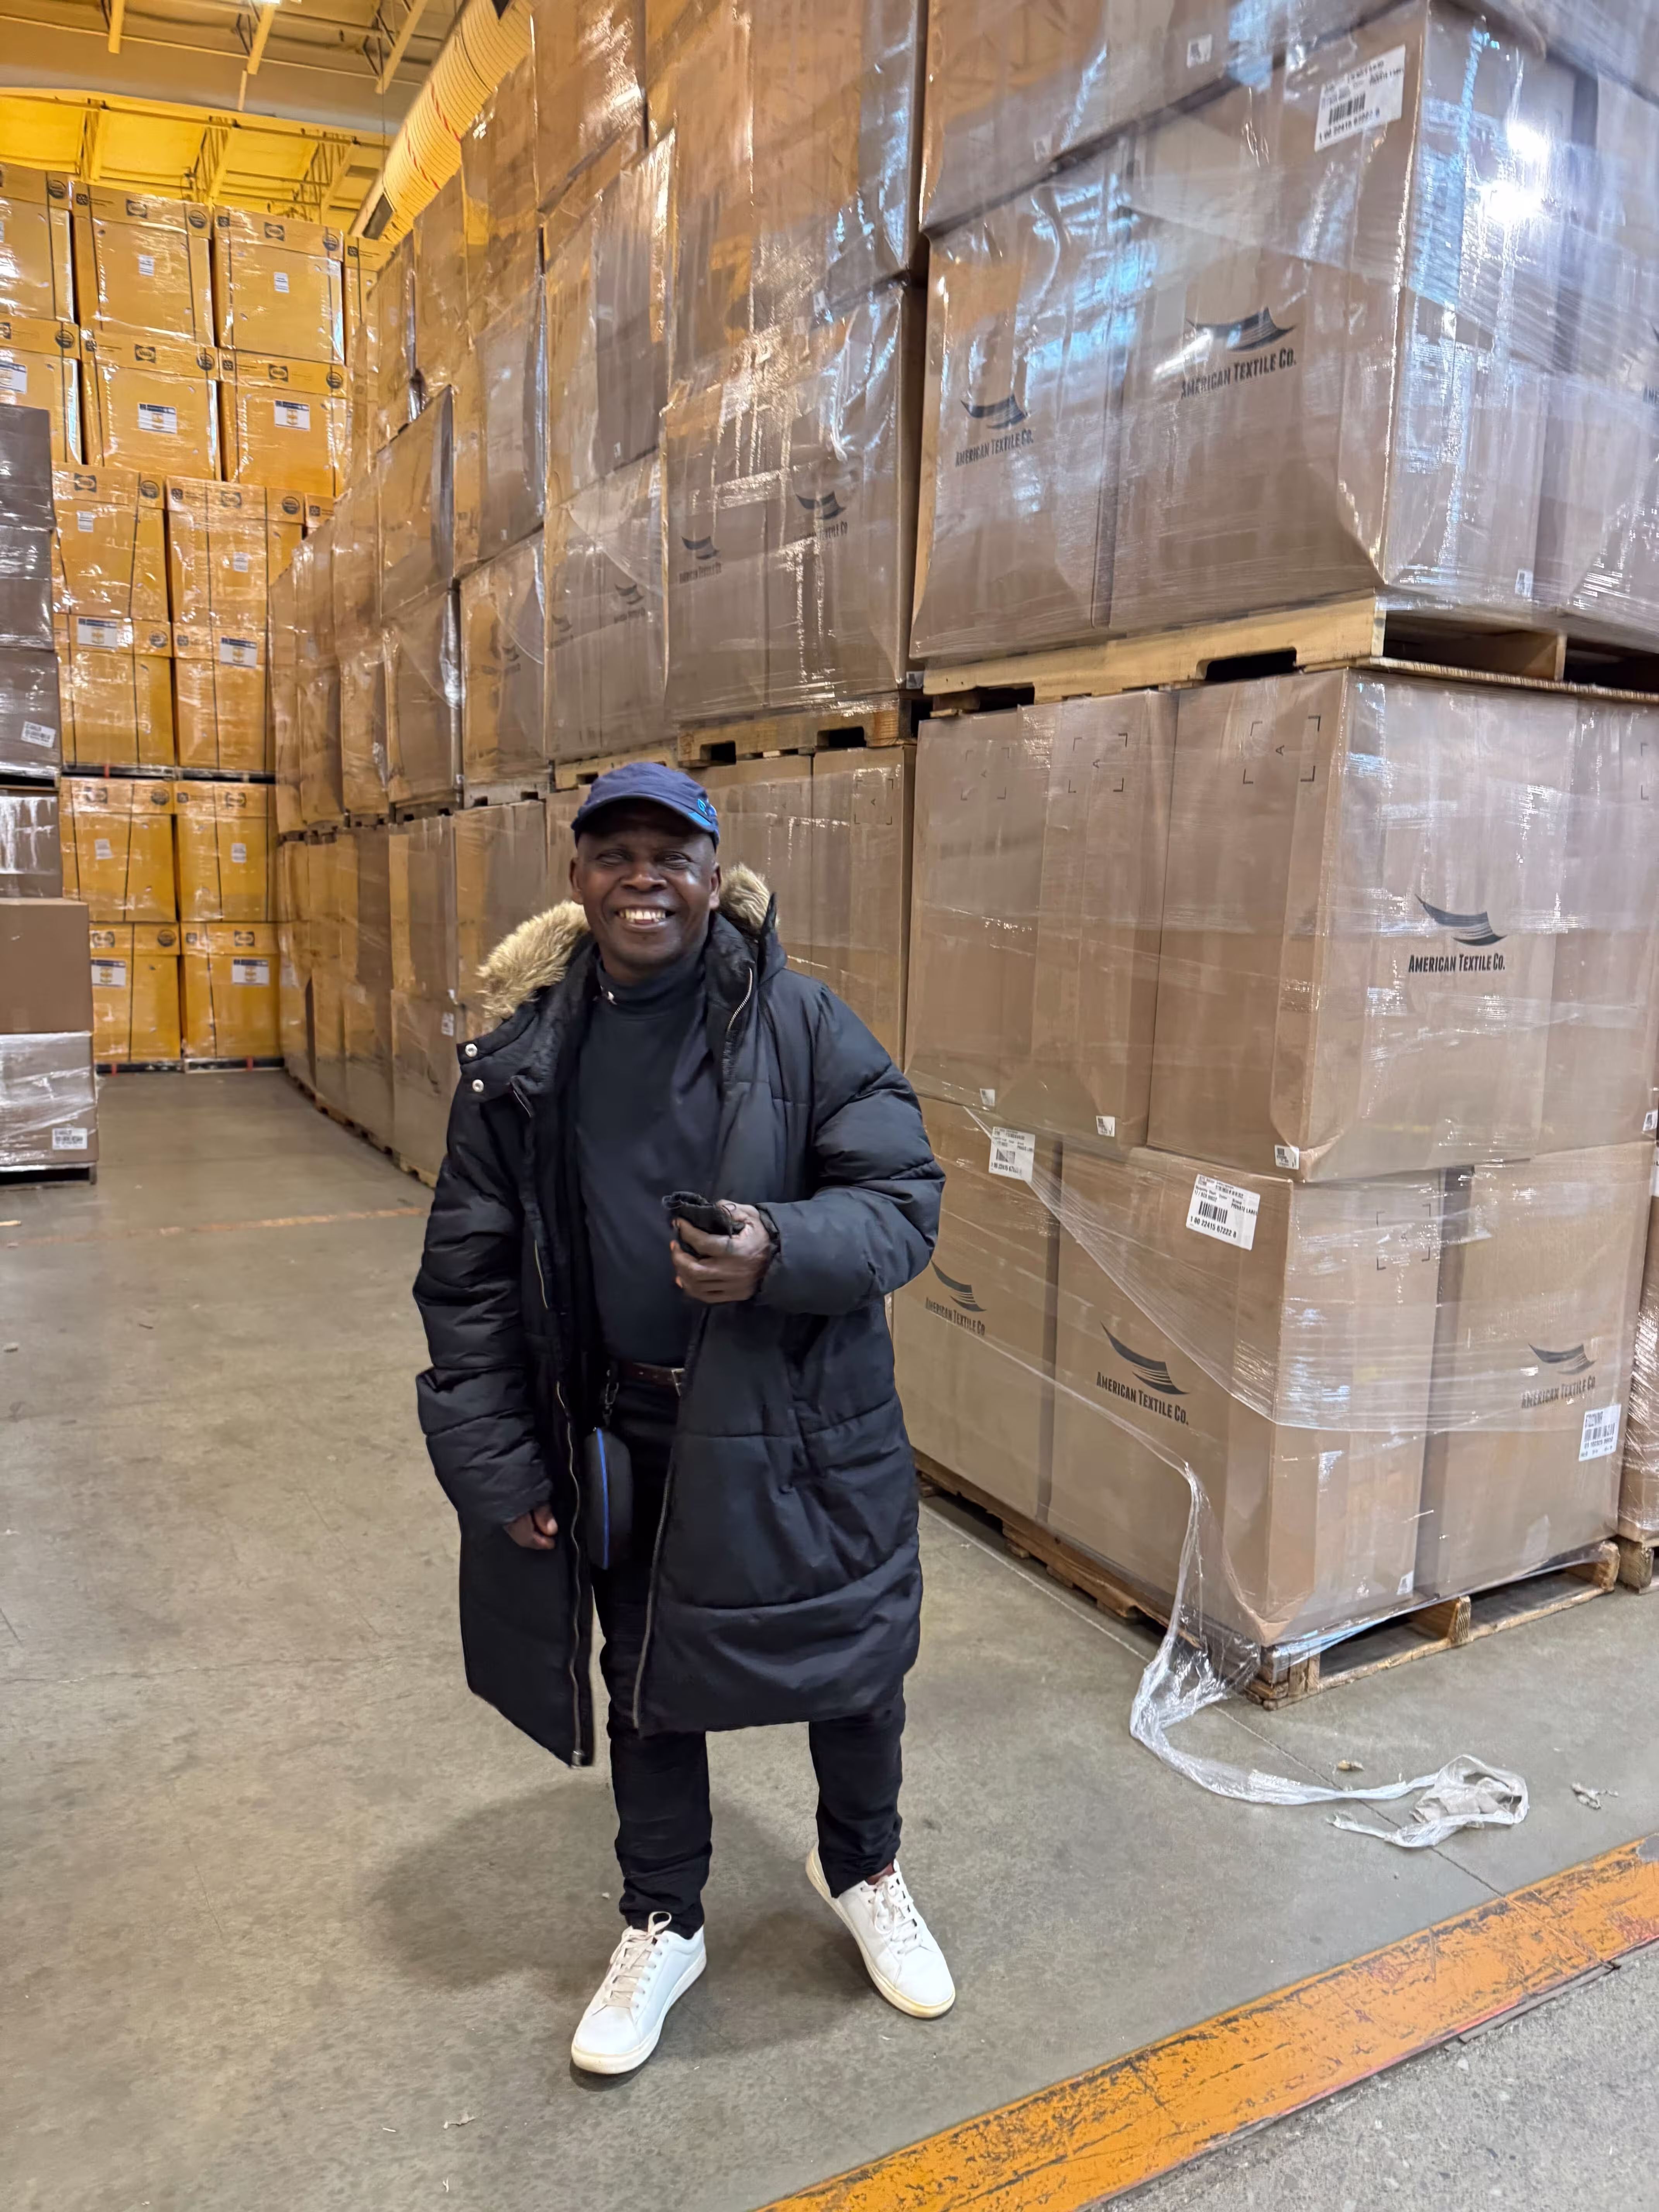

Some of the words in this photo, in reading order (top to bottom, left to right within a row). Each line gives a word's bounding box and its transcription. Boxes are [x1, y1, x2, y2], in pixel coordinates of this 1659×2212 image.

[1181, 367, 1231, 399] AMERICAN
[1234, 353, 1277, 382] TEXTILE
[1279, 347, 1297, 369] CO.
[955, 442, 990, 467] AMERICAN
[991, 433, 1020, 455] TEXTILE
[1275, 745, 1285, 756] A
[1408, 954, 1456, 973] AMERICAN
[1459, 954, 1492, 972] TEXTILE
[1493, 953, 1505, 970] CO.
[1201, 1219, 1216, 1231] 22415
[1216, 1224, 1232, 1237] 67222
[925, 1296, 952, 1321] AMERICAN
[953, 1309, 976, 1332] TEXTILE
[1096, 1371, 1137, 1403] AMERICAN
[1138, 1389, 1173, 1419] TEXTILE
[1174, 1403, 1189, 1426] CO.
[1521, 1387, 1559, 1409] AMERICAN
[1561, 1379, 1586, 1399] TEXTILE
